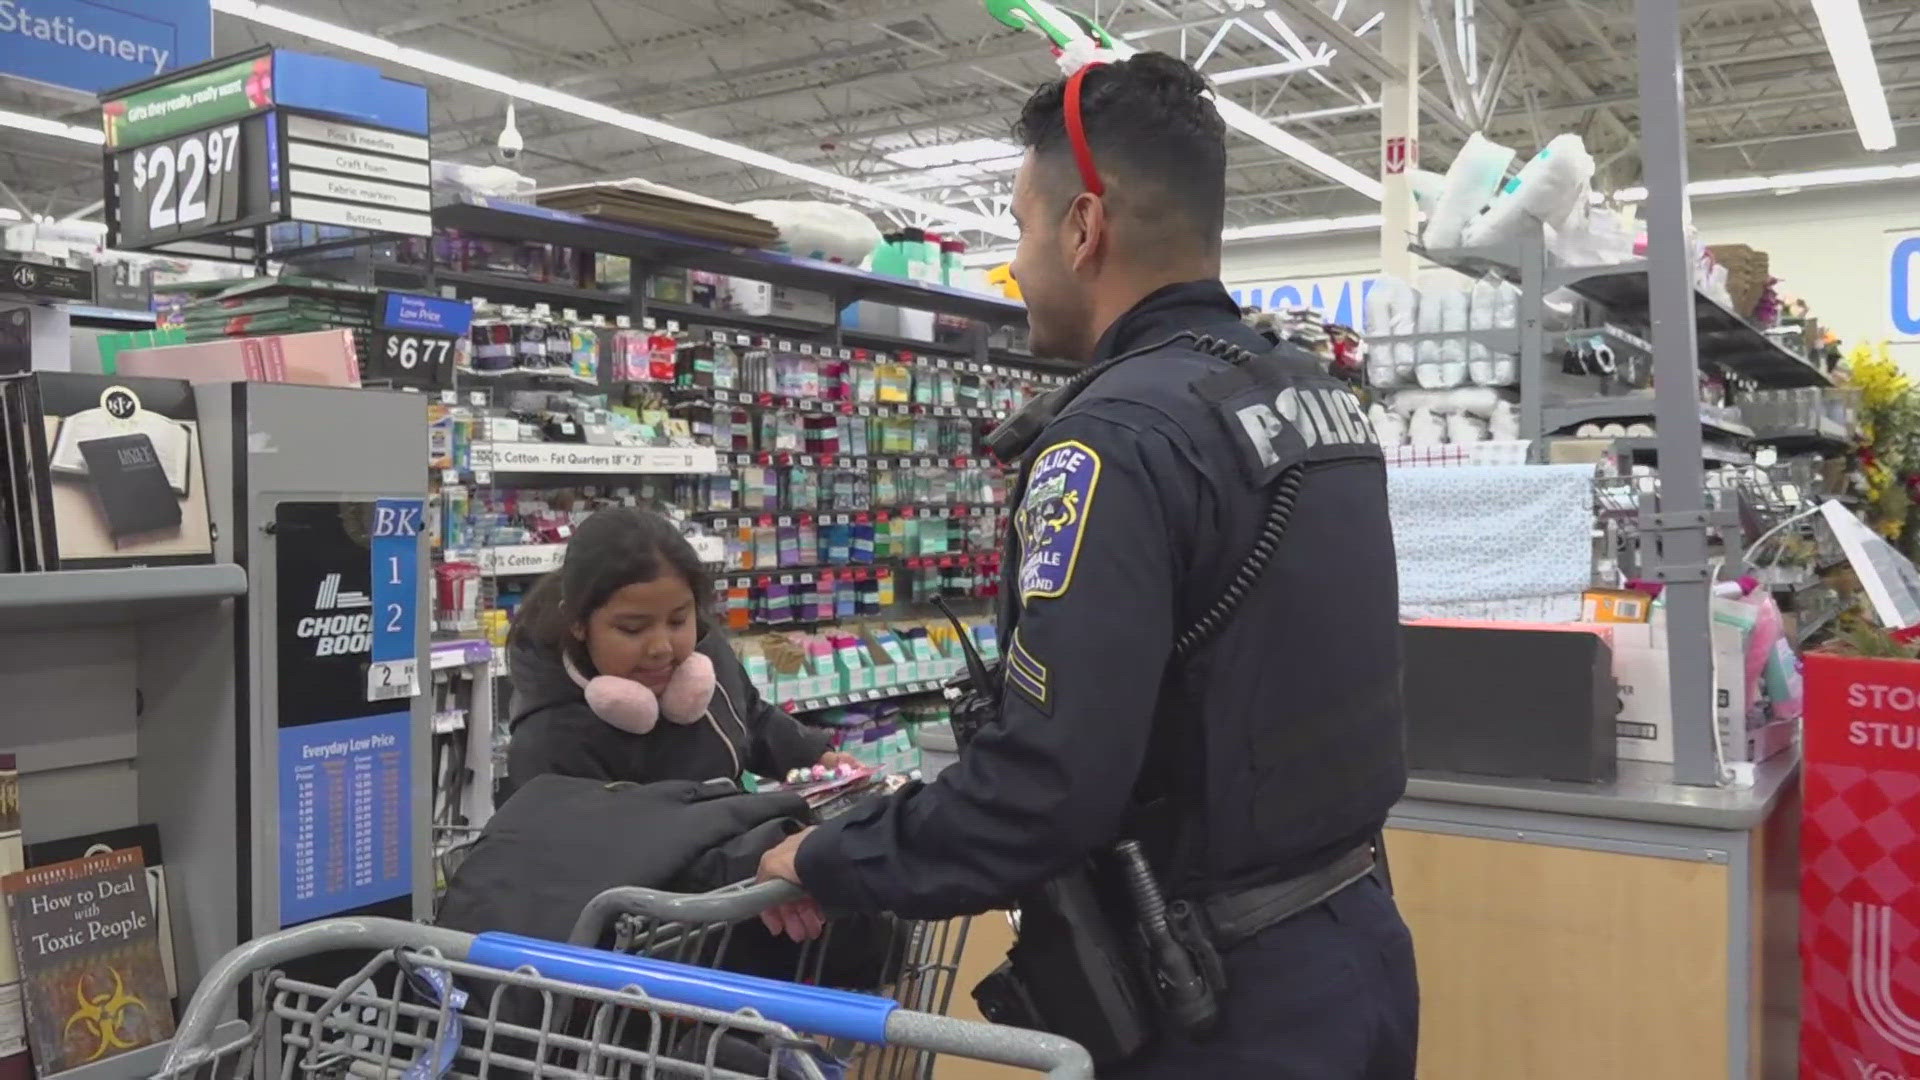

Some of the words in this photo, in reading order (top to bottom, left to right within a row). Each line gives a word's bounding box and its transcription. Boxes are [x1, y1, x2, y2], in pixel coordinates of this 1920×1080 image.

[0, 0, 169, 75] Stationery
[336, 157, 360, 169] Craft
[364, 161, 388, 172] foam
[328, 182, 357, 195] Fabric
[345, 211, 382, 225] Buttons
[400, 306, 417, 318] Low
[419, 309, 441, 322] Price
[505, 452, 540, 464] Cotton
[551, 453, 565, 465] Fat
[568, 455, 609, 466] Quarters
[1033, 449, 1086, 480] OLICE
[375, 507, 419, 537] BK
[388, 557, 402, 584] 1
[508, 554, 543, 567] Cotton
[386, 603, 403, 632] 2
[383, 666, 391, 686] 2
[1848, 682, 1920, 711] STO
[303, 741, 348, 760] Everyday
[350, 737, 370, 752] Low
[371, 733, 396, 749] Price
[1848, 720, 1920, 750] STU
[31, 893, 72, 915] How
[78, 888, 95, 905] to
[98, 873, 136, 900] Deal
[73, 902, 101, 921] with
[32, 926, 85, 956] Toxic
[88, 910, 148, 941] People
